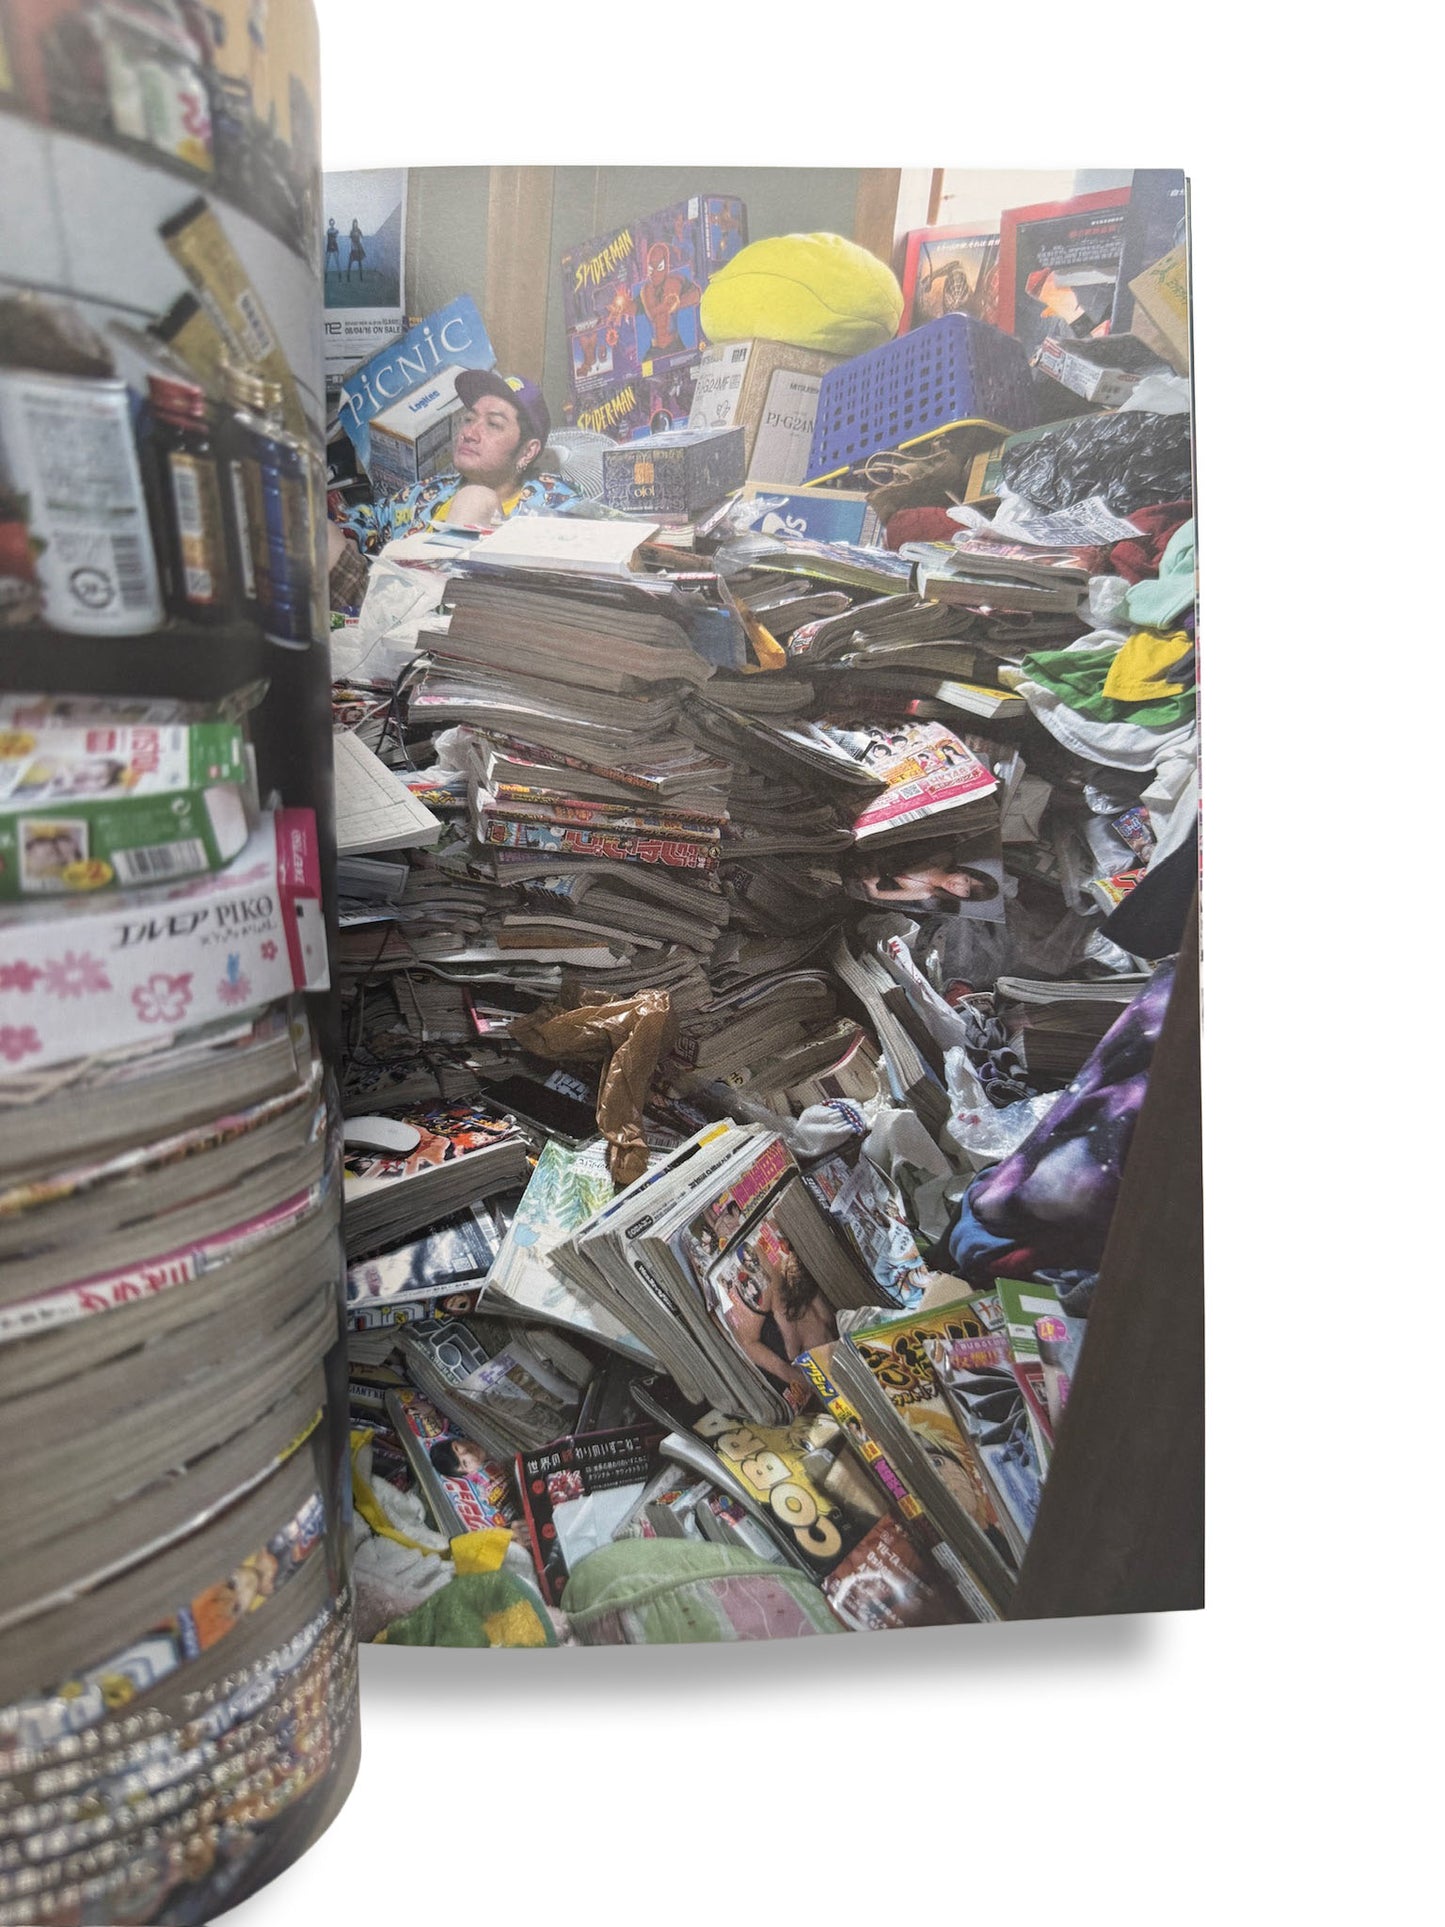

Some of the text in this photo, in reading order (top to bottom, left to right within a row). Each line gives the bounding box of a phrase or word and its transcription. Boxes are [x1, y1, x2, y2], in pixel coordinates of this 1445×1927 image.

[575, 229, 634, 293] SPIDER-MAN
[577, 385, 637, 434] SPIDER-MAN
[216, 896, 274, 928] PIKO
[692, 1407, 842, 1558] COBRA
